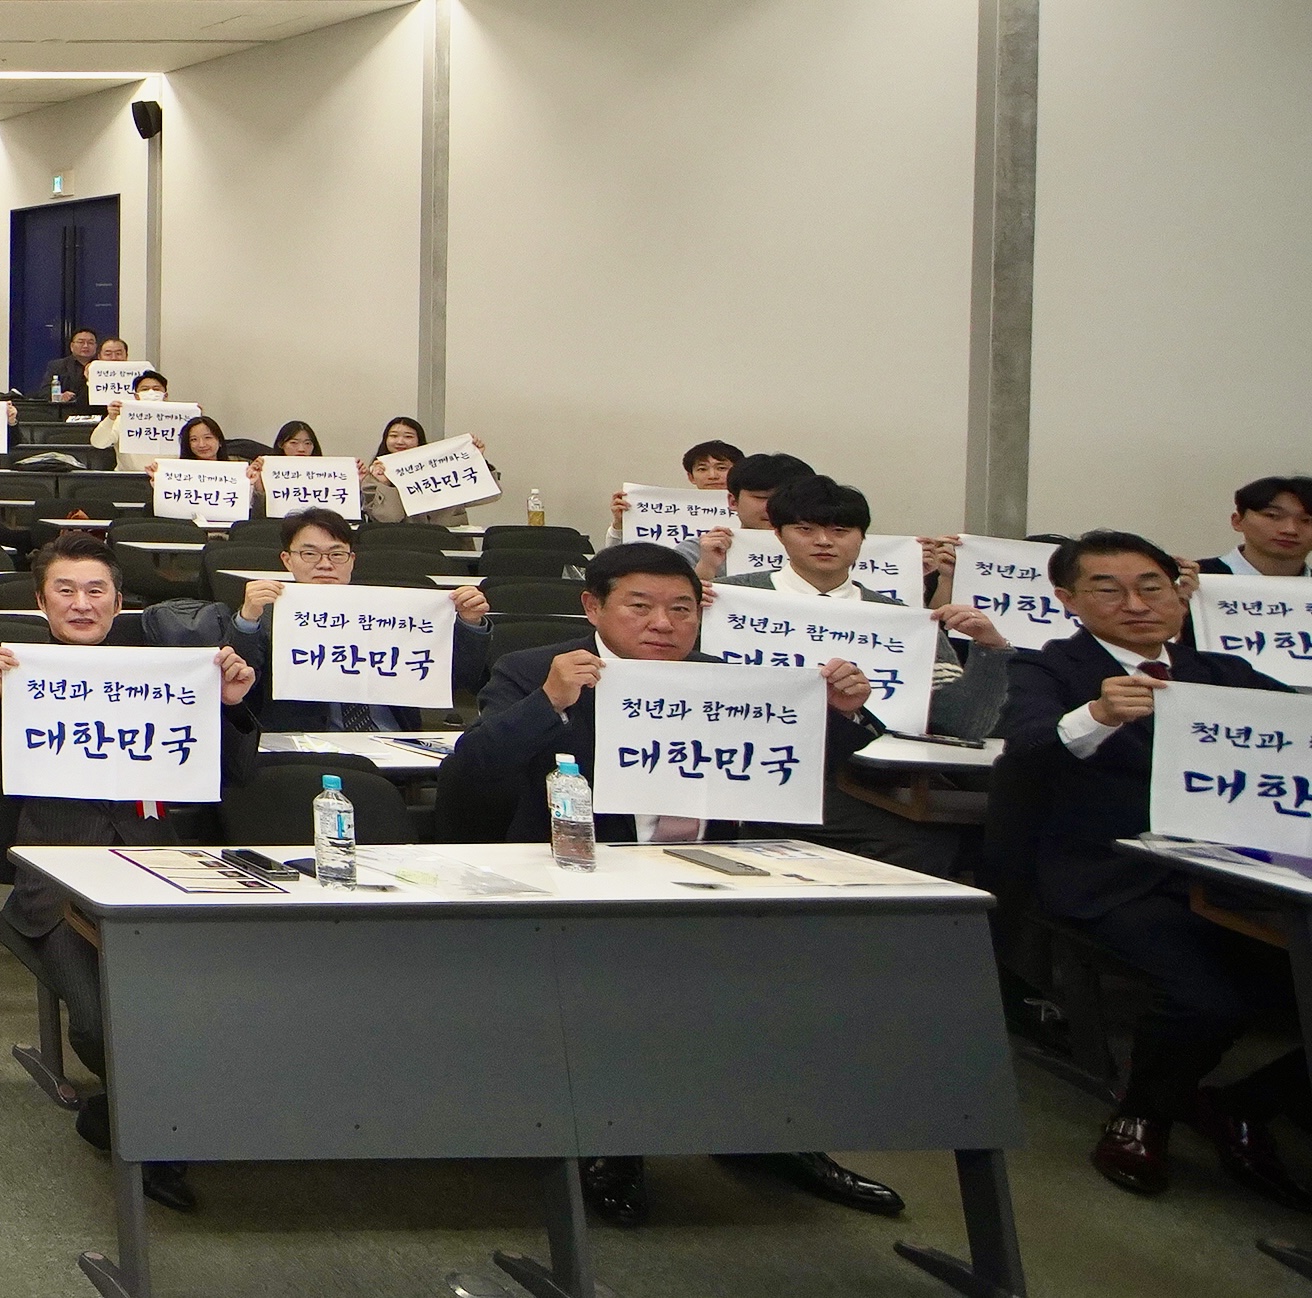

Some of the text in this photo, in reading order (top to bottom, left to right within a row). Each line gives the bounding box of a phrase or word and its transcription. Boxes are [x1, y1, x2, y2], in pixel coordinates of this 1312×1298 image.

[127, 427, 180, 441] 대한민
[405, 463, 477, 494] 대한민국
[164, 490, 238, 507] 대한민국
[273, 487, 348, 504] 대한민국
[637, 502, 736, 519] 청년과 함께하
[636, 523, 711, 544] 대한
[747, 552, 899, 576] 청년 하는
[976, 562, 1041, 581] 청년과
[972, 593, 1082, 628] 대한
[1218, 601, 1293, 617] 청년과
[295, 612, 433, 633] 청년과 함께하는
[728, 614, 904, 653] 청년과 함께하는
[1220, 631, 1312, 660] 대한
[292, 644, 435, 680] 대한민국
[28, 679, 195, 705] 청년과 함께하는
[622, 698, 797, 724] 청년과 함께하는
[26, 721, 197, 765] 대한민국
[1192, 722, 1293, 753] 청년과
[618, 740, 800, 786] 대한민국
[1183, 769, 1312, 818] 대한
